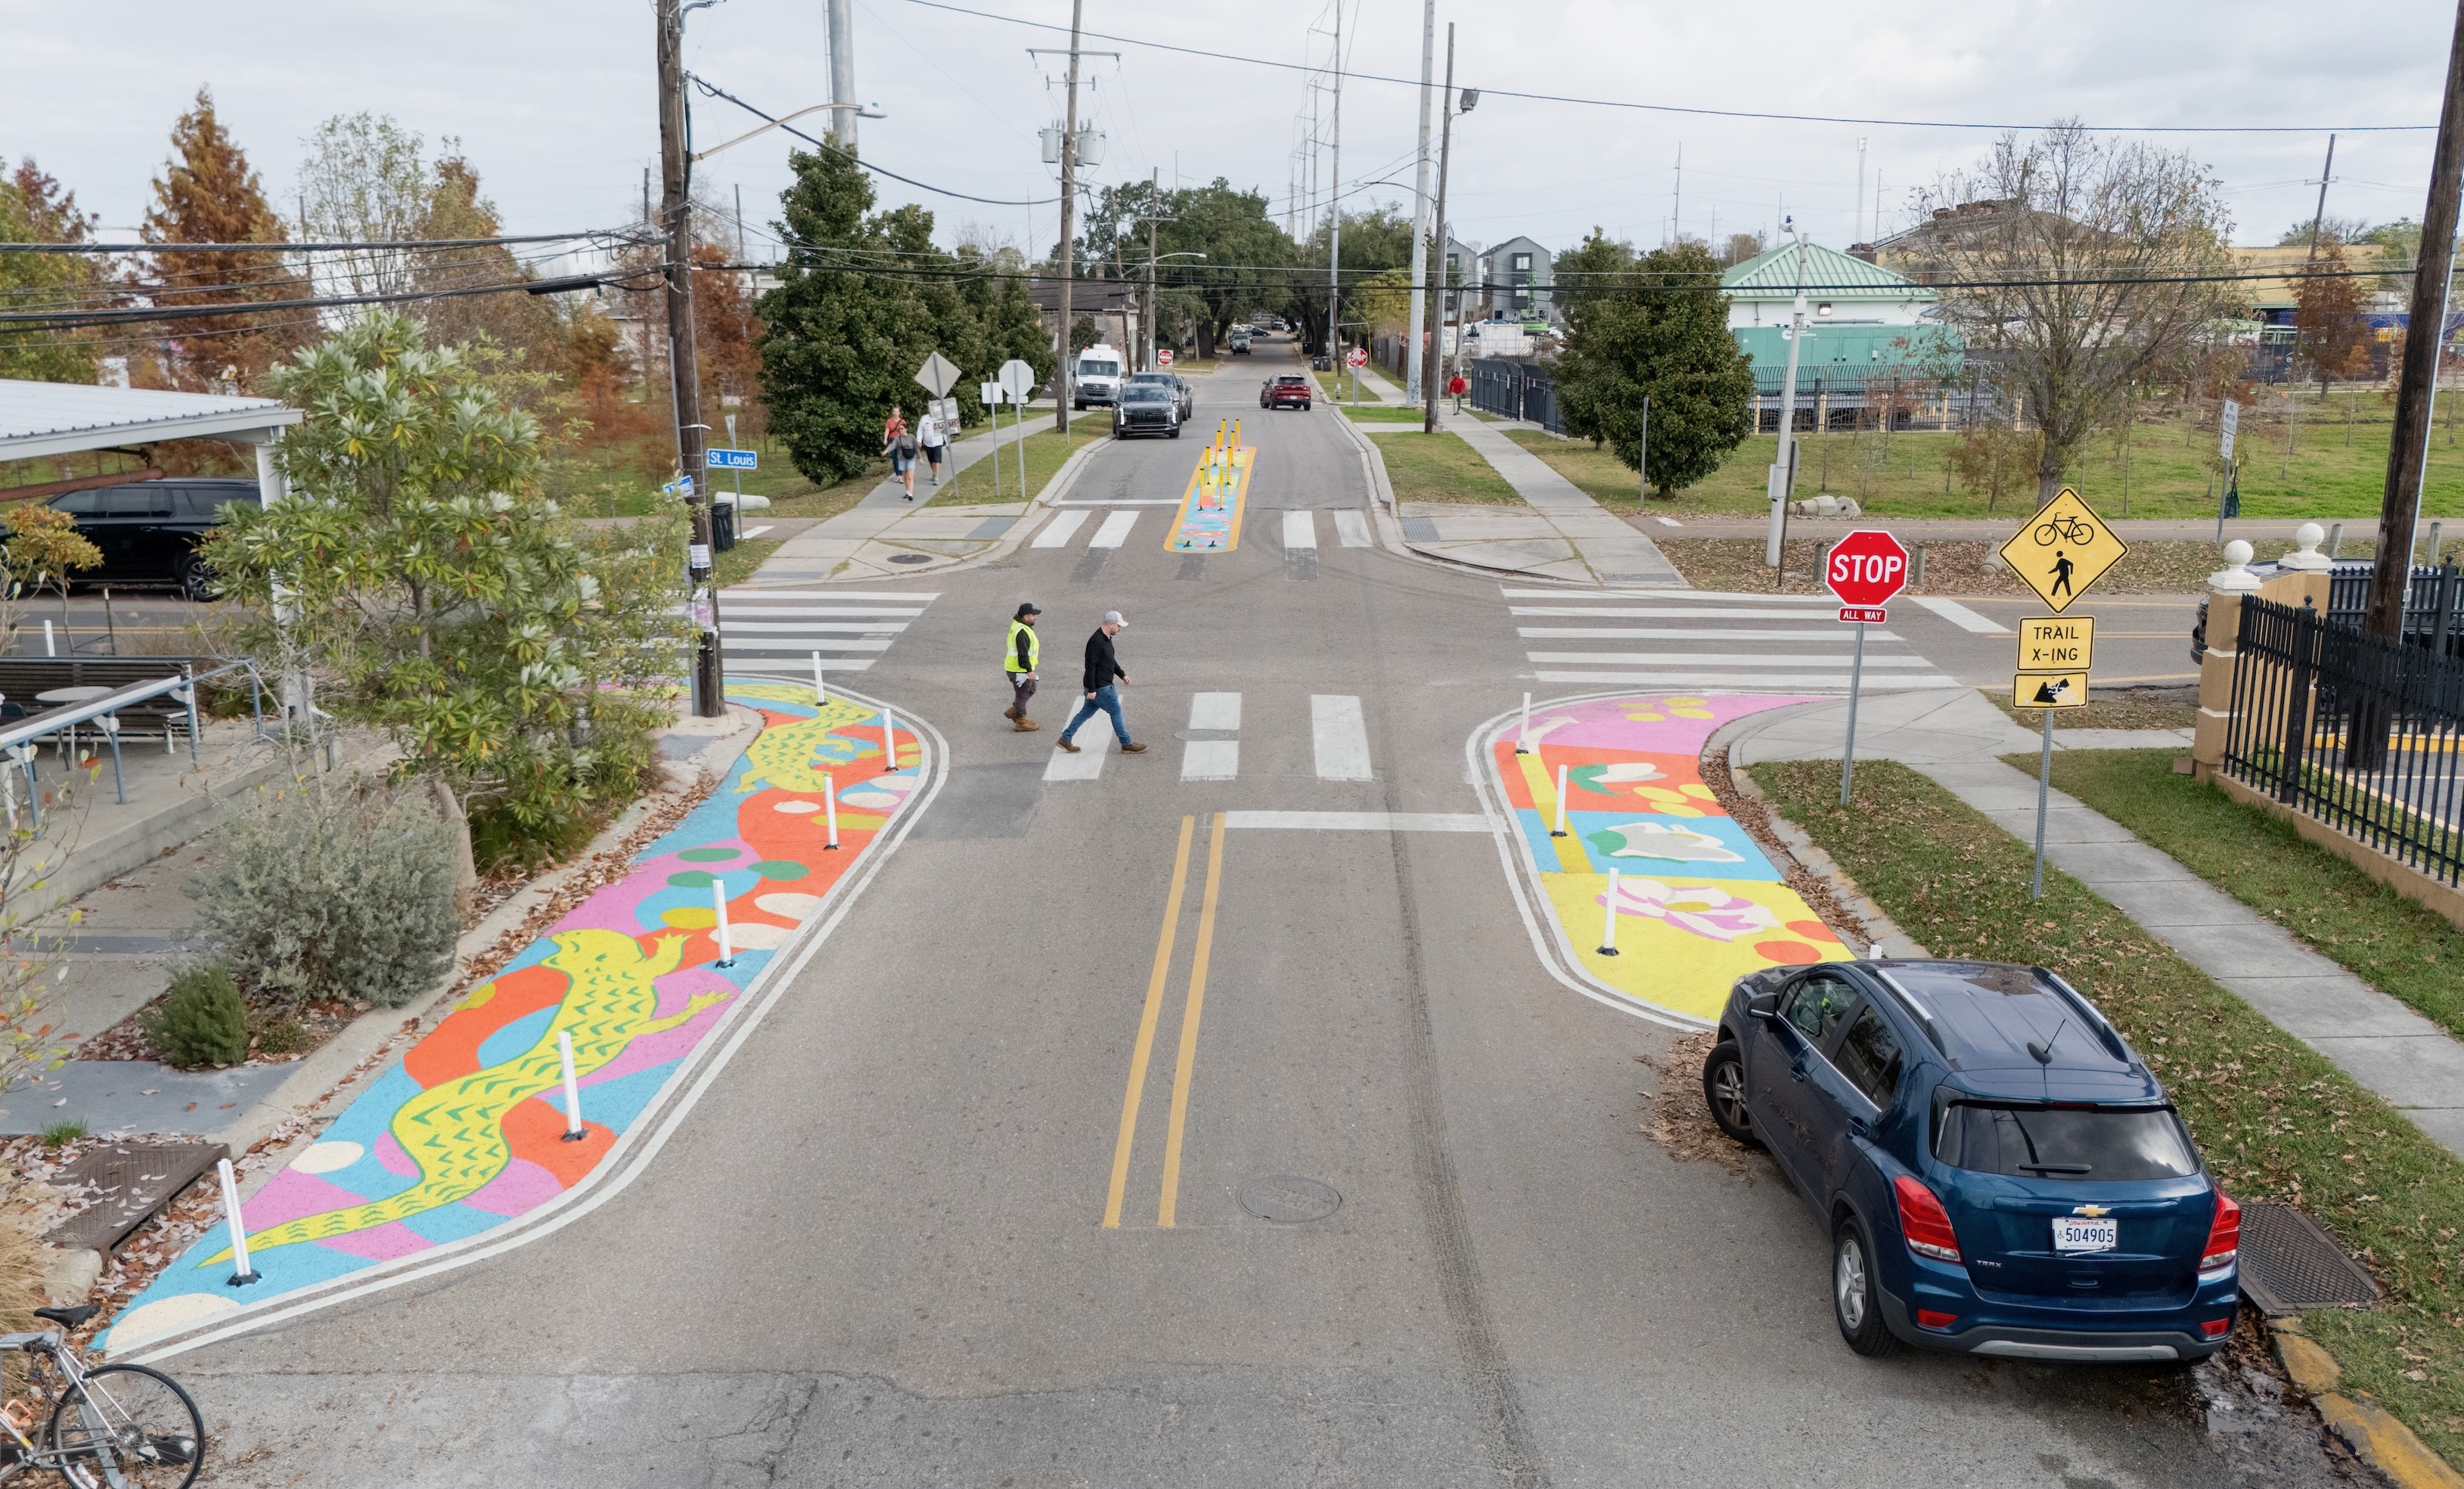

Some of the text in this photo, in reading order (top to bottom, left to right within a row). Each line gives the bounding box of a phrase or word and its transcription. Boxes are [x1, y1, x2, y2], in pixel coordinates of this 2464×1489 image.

[727, 453, 754, 467] Louis
[1832, 554, 1902, 584] STOP
[1843, 610, 1882, 621] ALL WAY
[2034, 626, 2079, 640] TRAIL
[2032, 647, 2078, 661] X-ING
[2065, 1227, 2114, 1242] 504905
[1976, 1260, 2002, 1268] TRAX
